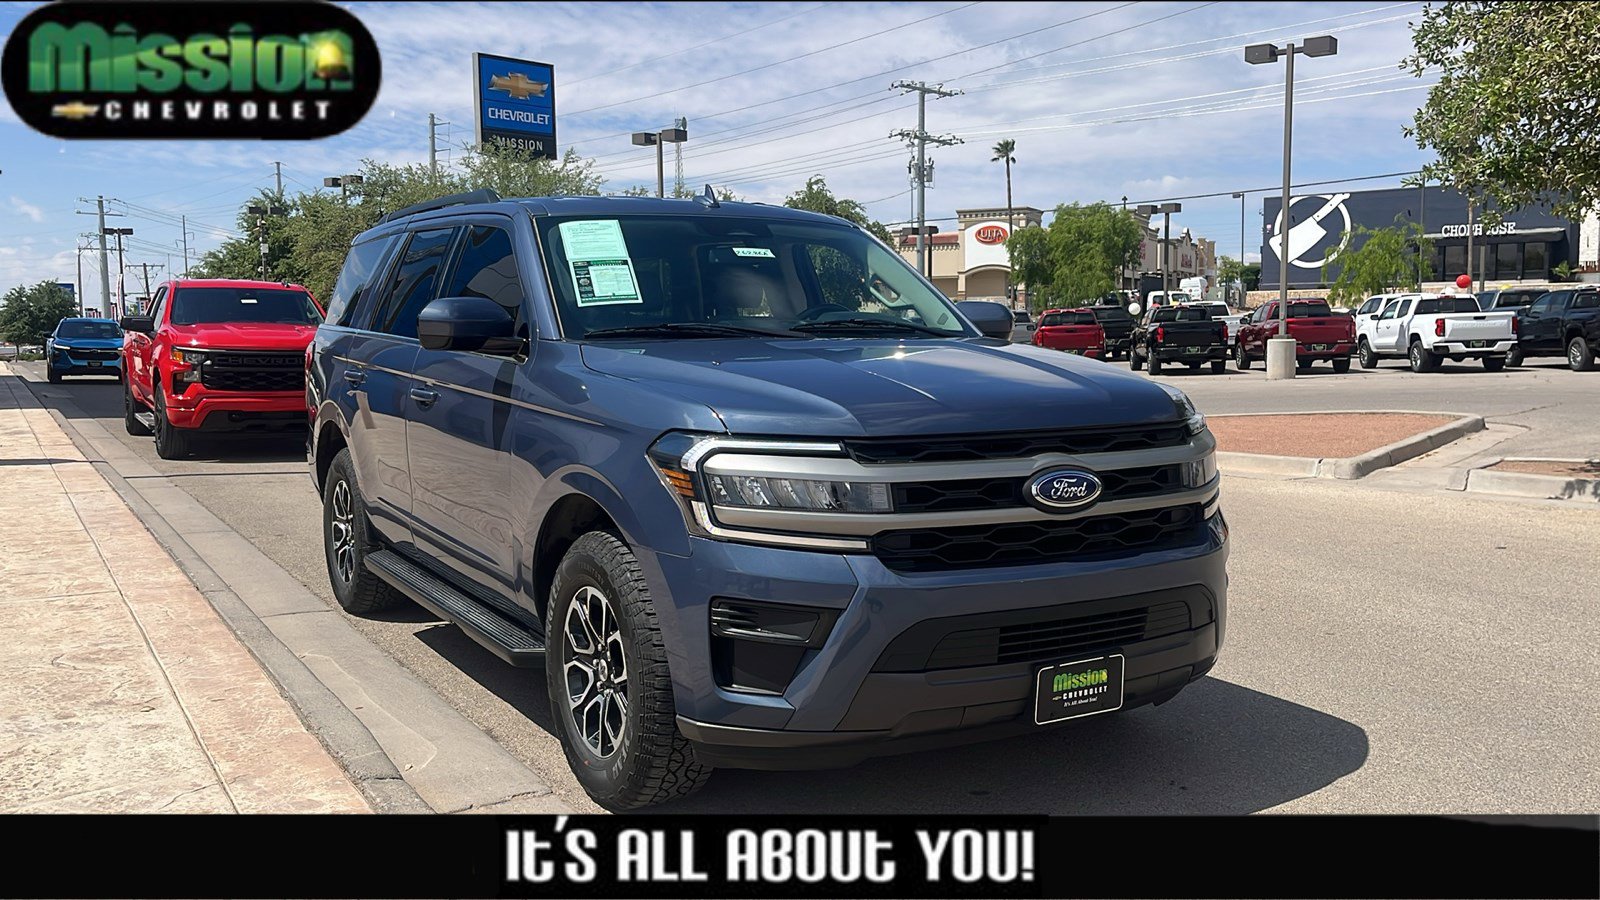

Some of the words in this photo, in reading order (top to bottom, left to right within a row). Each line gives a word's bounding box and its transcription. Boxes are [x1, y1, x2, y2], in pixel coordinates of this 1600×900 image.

[488, 107, 550, 125] CHEVROLET
[499, 136, 543, 151] MISSION
[1050, 478, 1088, 499] Ford
[1053, 669, 1108, 692] Mission
[1062, 685, 1108, 700] CHEVROLET
